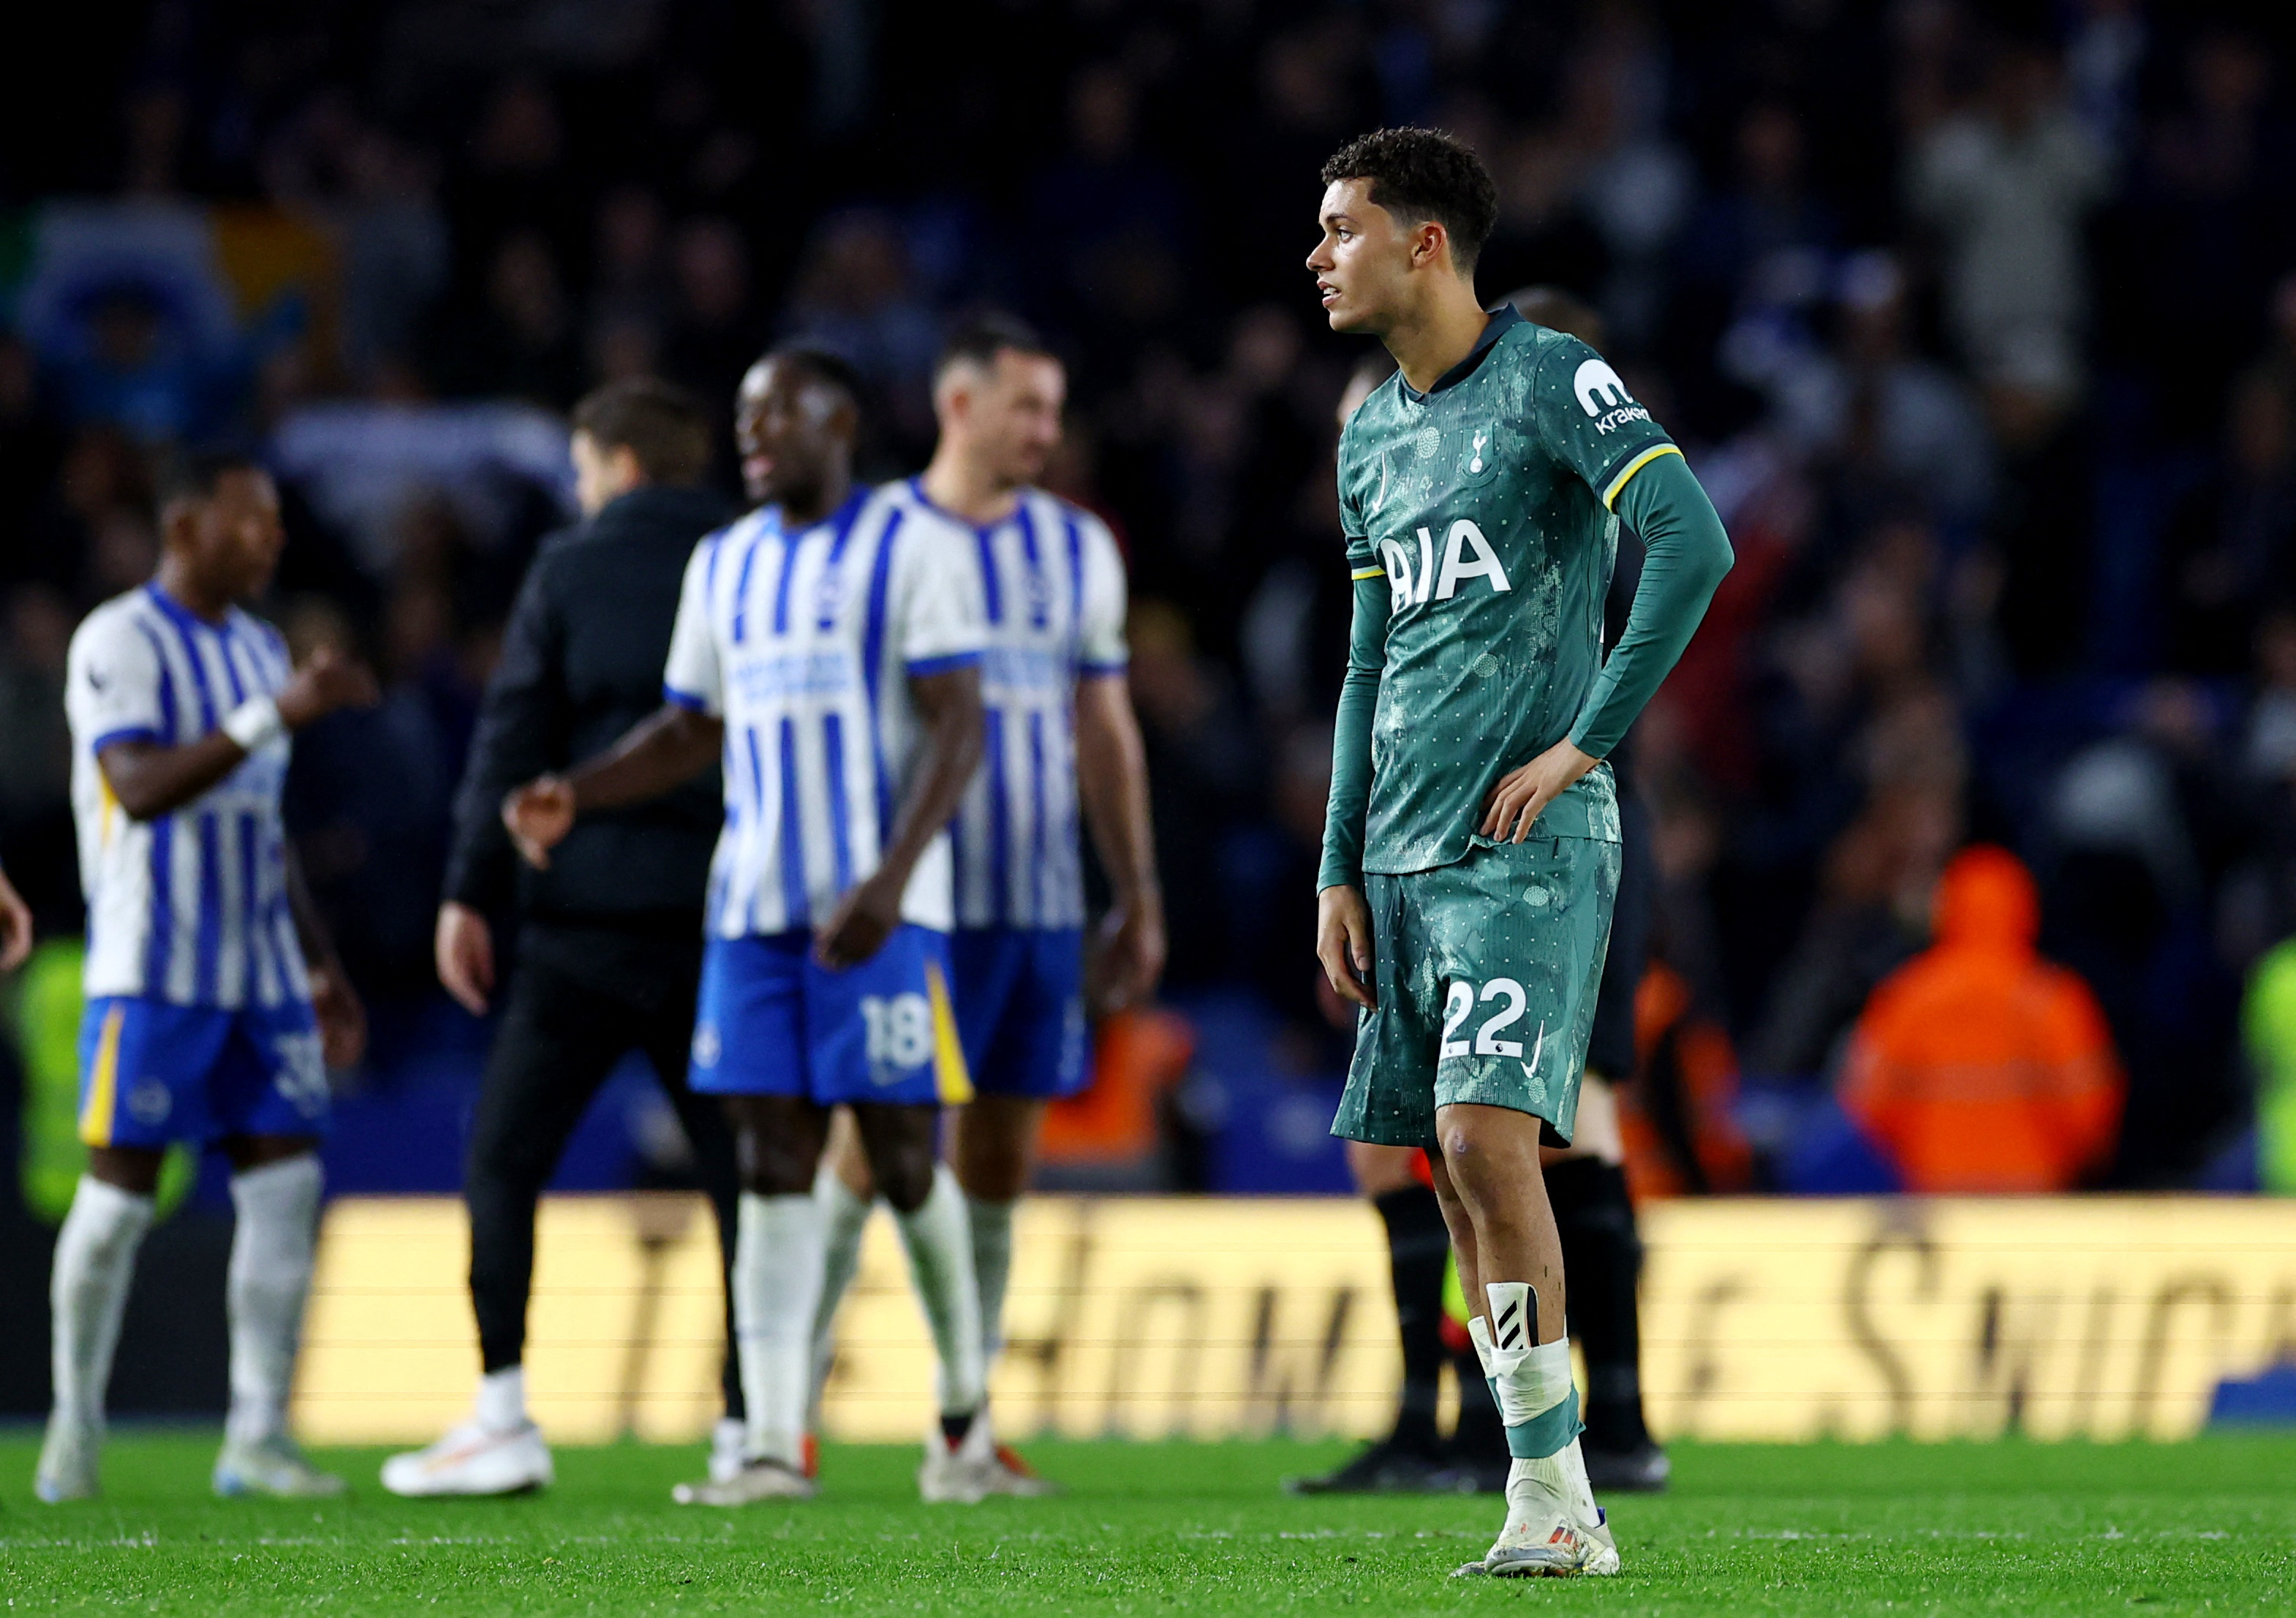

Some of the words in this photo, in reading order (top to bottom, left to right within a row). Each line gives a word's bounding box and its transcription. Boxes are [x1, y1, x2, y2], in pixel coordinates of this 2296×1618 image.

[1380, 518, 1512, 616] AIA
[859, 993, 932, 1067] 18
[1439, 978, 1527, 1060] 22
